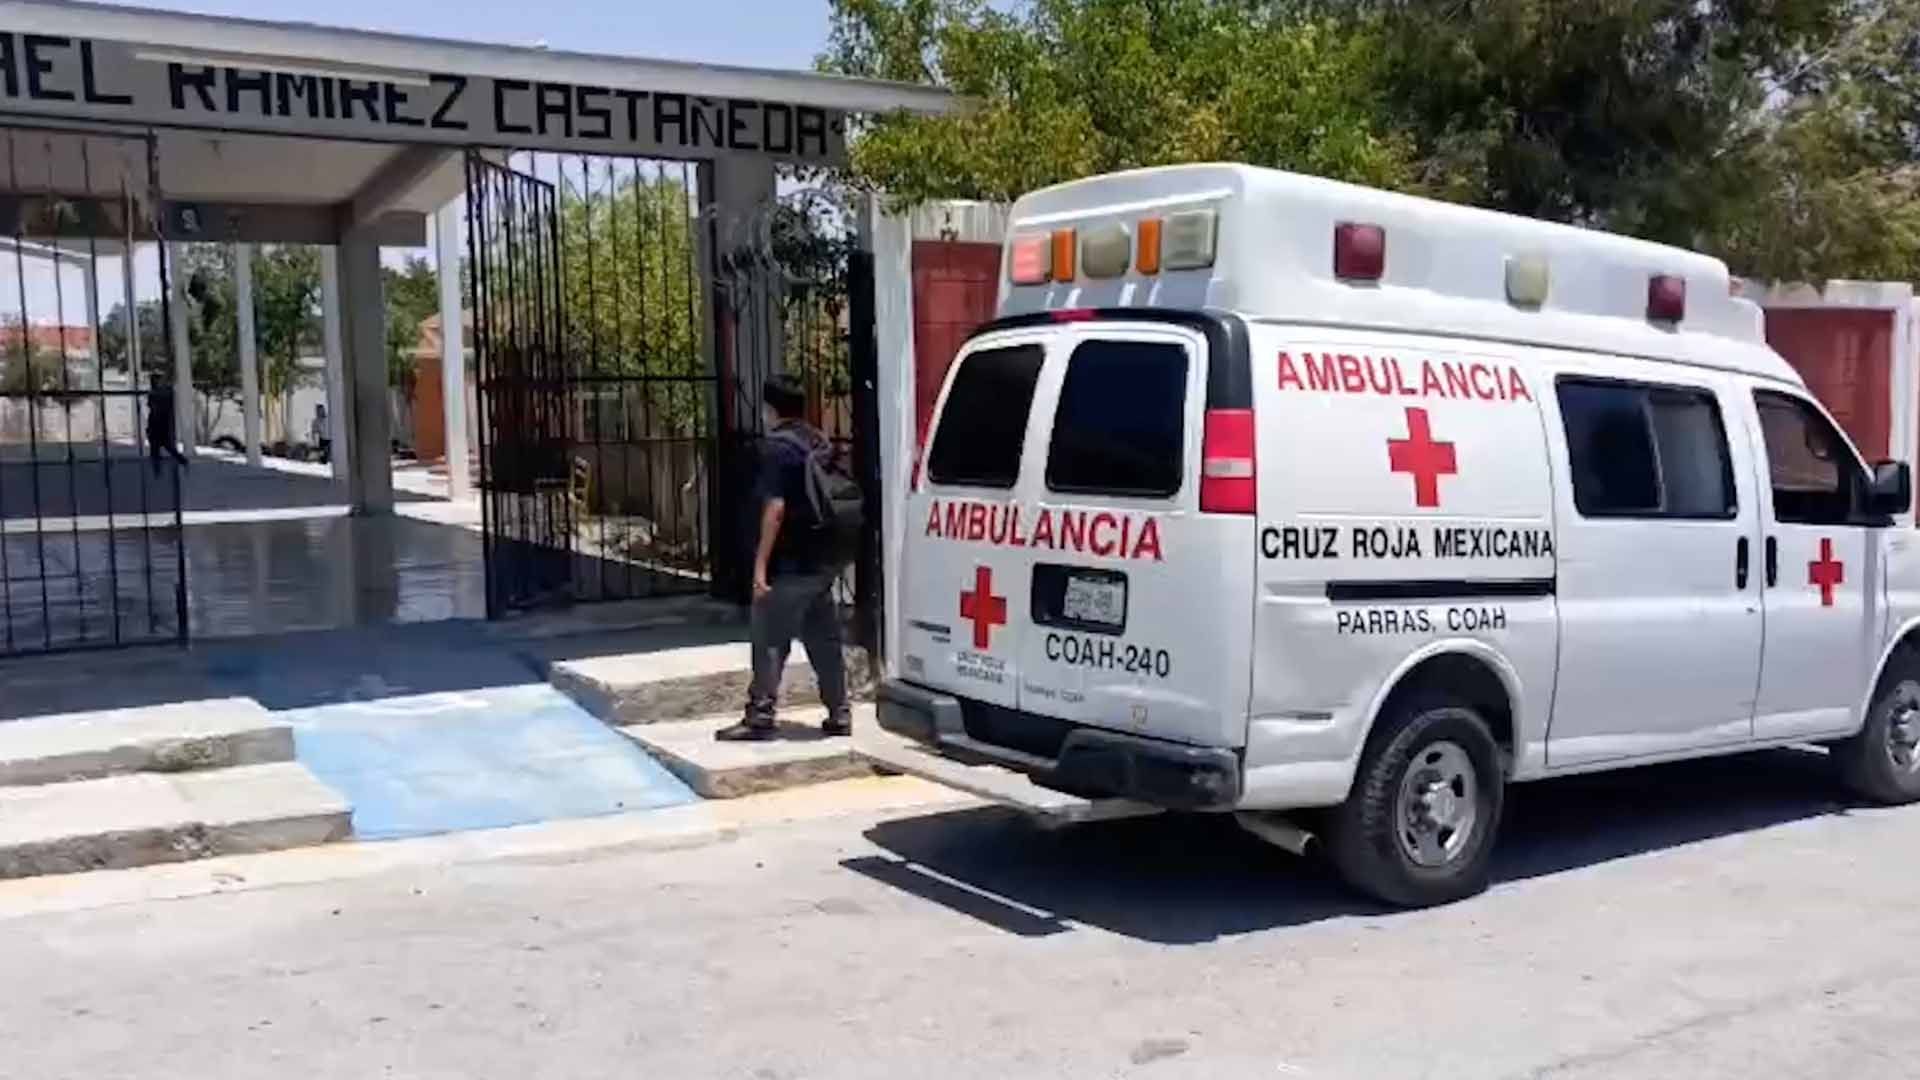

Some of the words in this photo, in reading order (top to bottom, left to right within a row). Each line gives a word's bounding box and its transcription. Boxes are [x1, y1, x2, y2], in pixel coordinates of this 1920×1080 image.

[1277, 351, 1533, 403] AMBULANCIA
[925, 500, 1163, 561] AMBULANCIA
[1261, 527, 1338, 559] CRUZ
[1353, 527, 1422, 558] ROJA
[1434, 527, 1554, 558] MEXICANA
[1447, 606, 1507, 632] COAH
[1045, 633, 1170, 678] COAH-240
